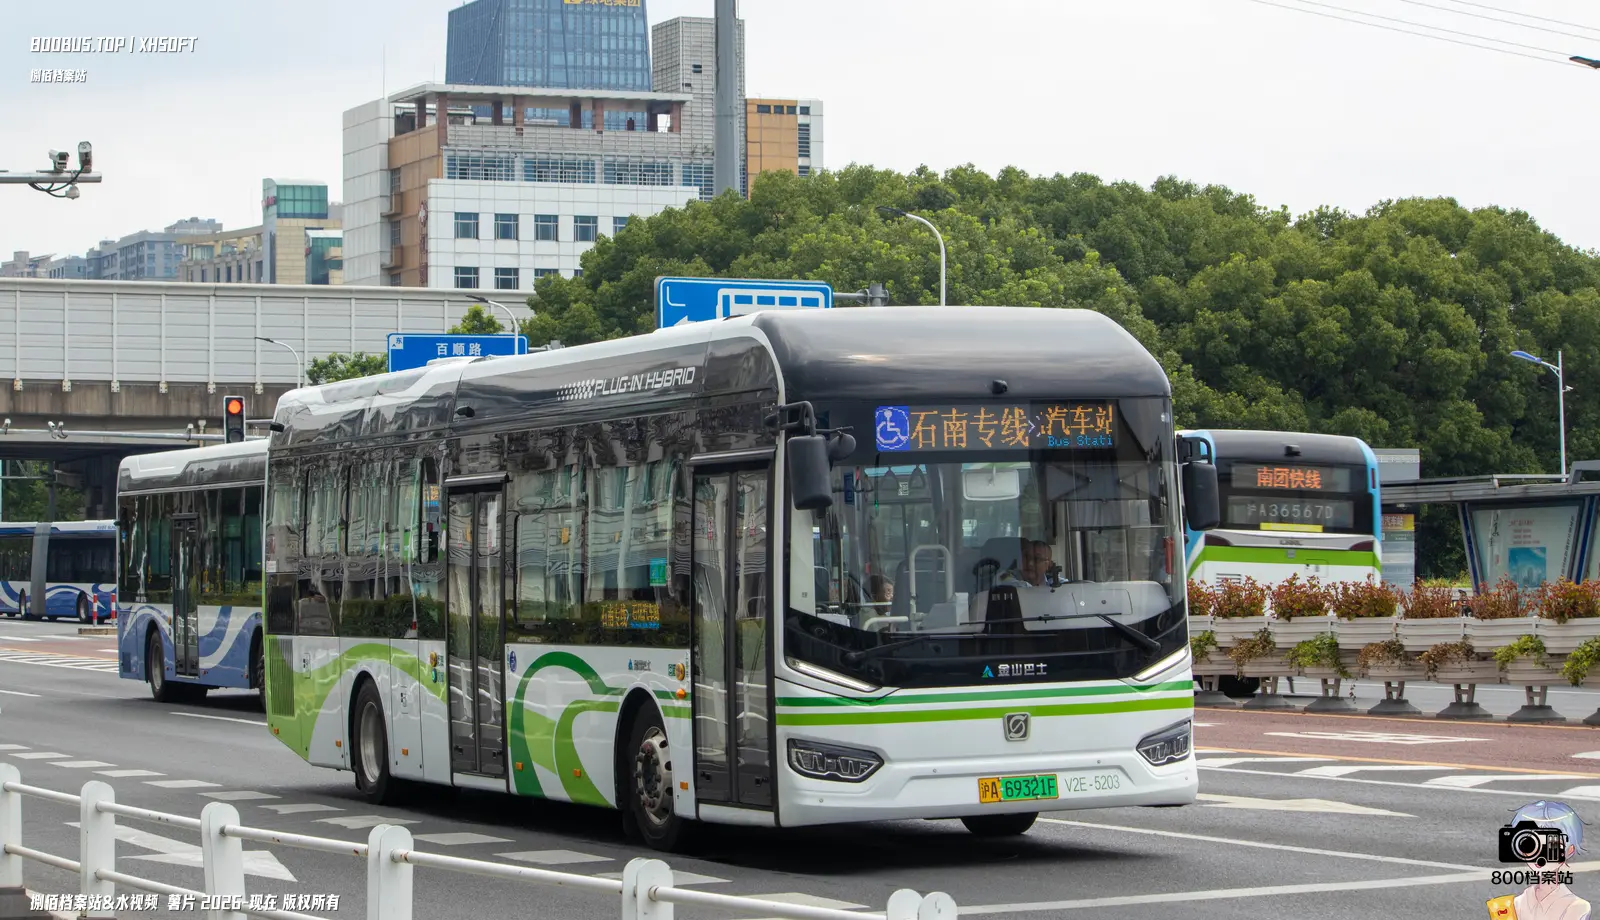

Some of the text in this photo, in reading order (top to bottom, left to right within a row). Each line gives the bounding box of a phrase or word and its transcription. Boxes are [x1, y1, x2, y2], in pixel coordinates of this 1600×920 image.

[436, 343, 481, 355] 百顺路
[594, 366, 696, 396] PLUG-IN HYBRID
[910, 407, 1029, 449] 石南专线
[1048, 435, 1070, 446] Bus
[1256, 467, 1322, 489] 南团快线
[1382, 515, 1404, 526] 汽车站
[998, 663, 1047, 677] 金山巴士
